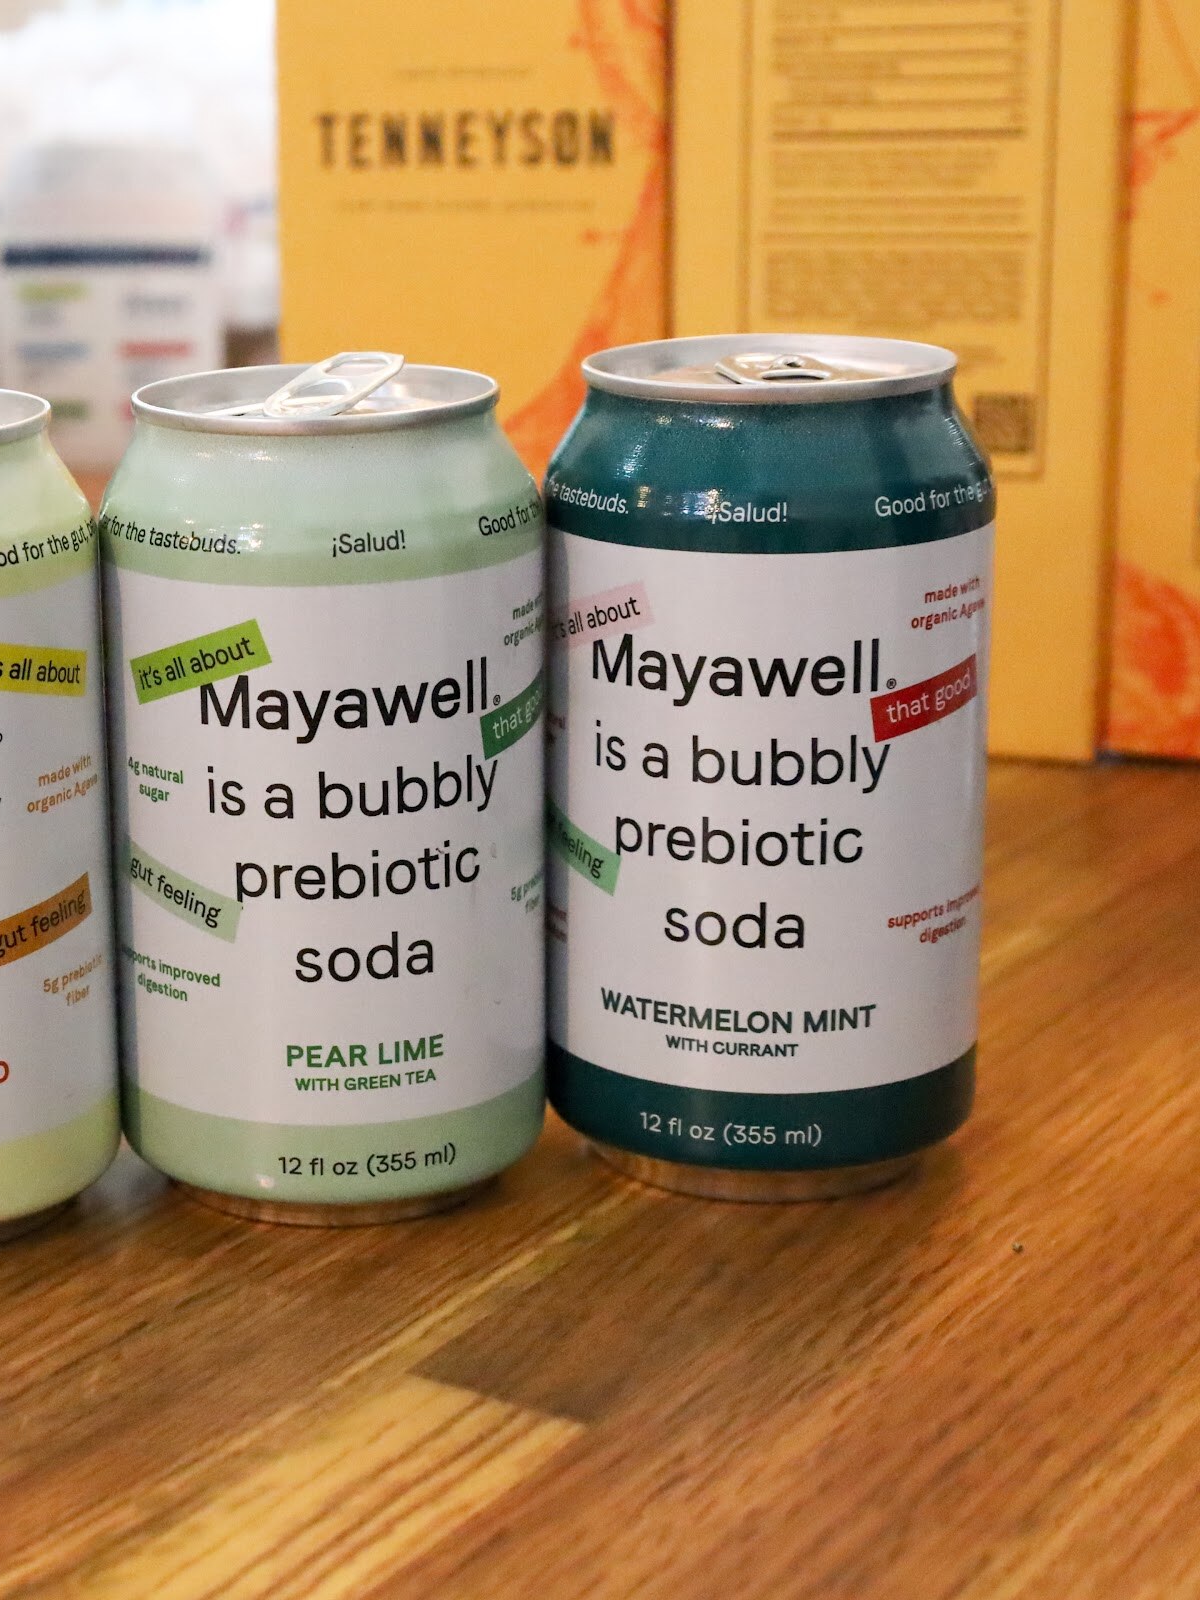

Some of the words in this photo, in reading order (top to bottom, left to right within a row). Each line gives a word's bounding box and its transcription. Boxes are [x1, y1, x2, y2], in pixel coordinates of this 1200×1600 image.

[316, 109, 616, 169] TENNEYSON
[559, 483, 629, 515] tastebuds.
[875, 492, 926, 517] Good
[930, 489, 950, 510] for
[953, 483, 974, 504] the
[110, 516, 124, 537] for
[125, 521, 146, 544] the
[149, 526, 241, 555] tastebuds.
[478, 509, 516, 536] Good
[516, 506, 529, 526] for
[22, 539, 45, 562] for
[47, 533, 69, 555] the
[331, 530, 406, 557] ¡Salud!
[924, 584, 958, 604] made
[568, 611, 584, 635] all
[586, 596, 641, 629] about
[911, 606, 958, 630] organic
[8, 657, 32, 681] all
[36, 660, 81, 685] about
[138, 665, 163, 692] it's
[164, 656, 187, 683] all
[189, 635, 255, 675] about
[886, 694, 930, 725] that
[934, 670, 972, 712] good
[492, 706, 523, 740] that
[38, 765, 71, 787] made
[72, 753, 91, 774] with
[127, 755, 140, 776] 4g
[140, 761, 184, 785] natural
[595, 719, 627, 772] is
[641, 740, 669, 780] a
[691, 734, 891, 794] bubbly
[27, 787, 72, 813] organic
[138, 782, 170, 804] sugar
[207, 766, 246, 817] is
[264, 783, 294, 819] a
[318, 754, 498, 820] bubbly
[615, 816, 863, 867] prebiotic
[131, 855, 153, 889] gut
[156, 873, 221, 928] feeling
[235, 840, 481, 909] prebiotic
[30, 890, 87, 938] feeling
[664, 902, 806, 950] soda
[887, 903, 944, 929] supports
[158, 959, 221, 987] improved
[295, 931, 435, 983] soda
[137, 971, 188, 1001] digestion
[600, 987, 793, 1034] WATERMELON
[802, 1004, 877, 1034] MINT
[286, 1043, 368, 1068] PEAR
[378, 1034, 445, 1065] LIME
[665, 1034, 708, 1054] WITH
[712, 1041, 799, 1058] CURRANT
[295, 1076, 339, 1092] WITH
[344, 1073, 401, 1090] GREEN
[405, 1068, 437, 1085] TEA
[639, 1112, 661, 1133] 12
[667, 1117, 681, 1136] fl
[689, 1124, 715, 1141] oz
[722, 1122, 777, 1147] (355
[785, 1122, 823, 1147] ml)
[278, 1155, 302, 1175] 12
[309, 1157, 324, 1176] fl
[332, 1159, 358, 1176] oz
[366, 1150, 417, 1177] (355
[424, 1142, 457, 1167] ml)
